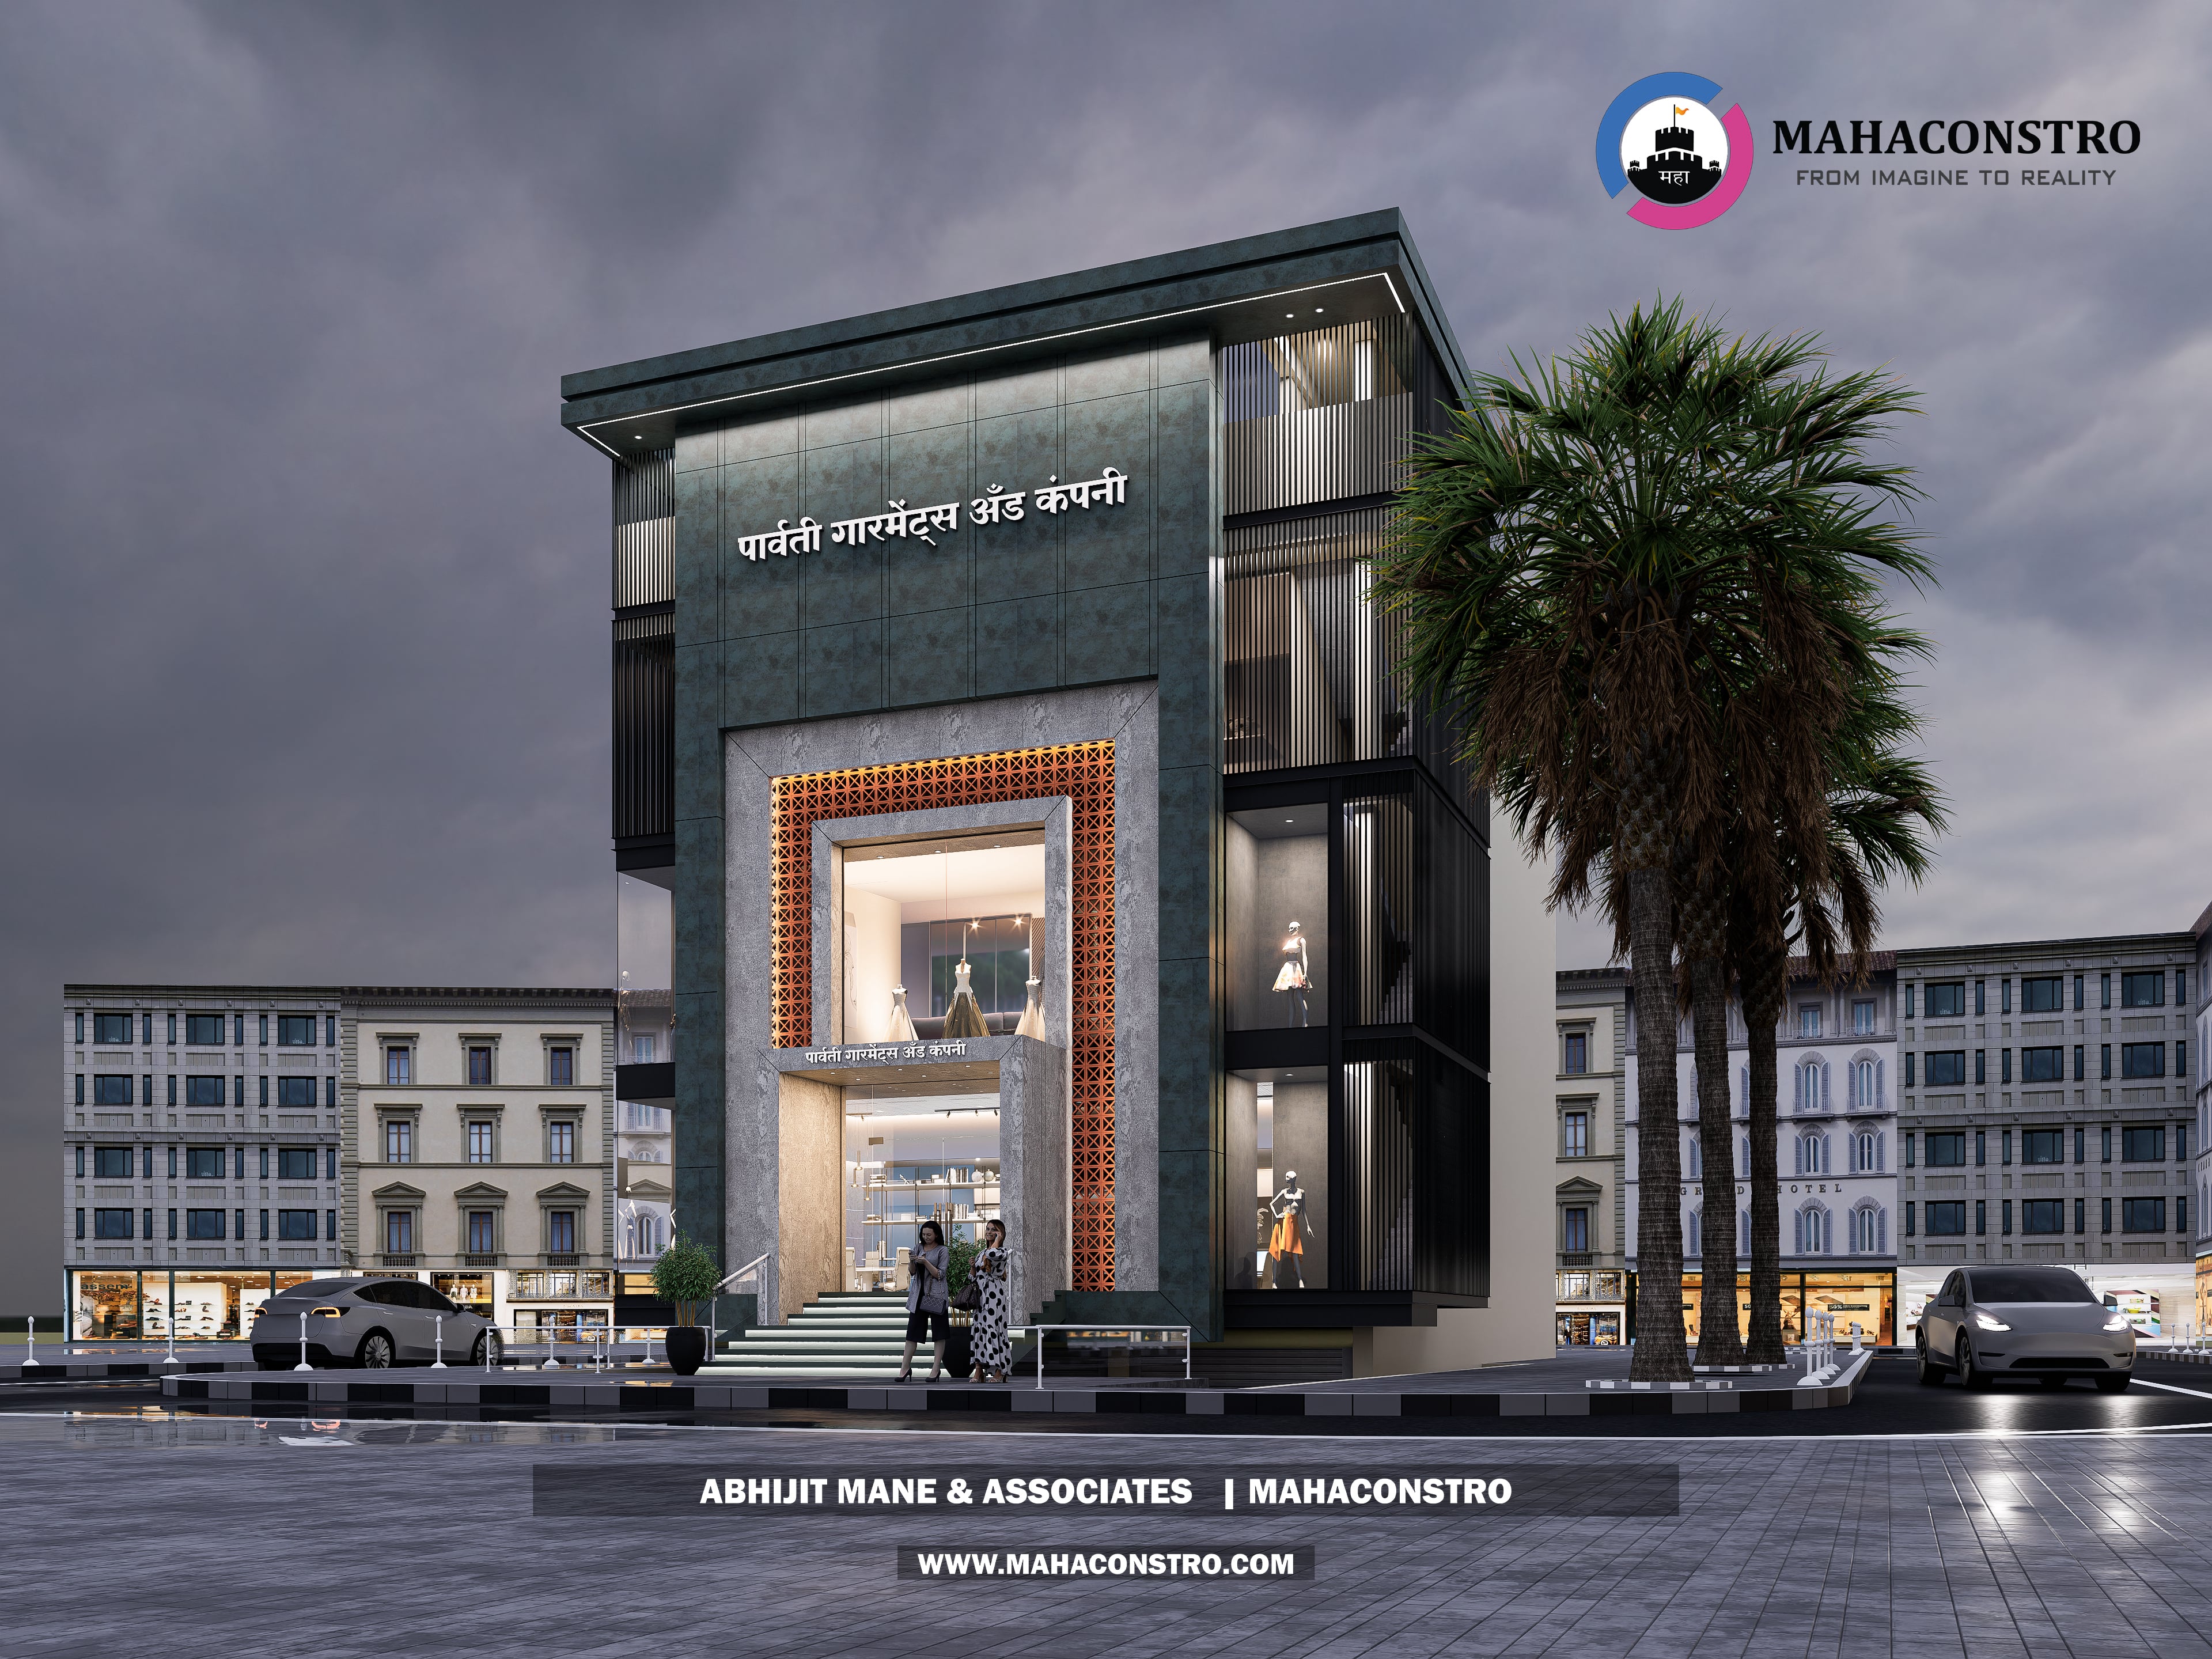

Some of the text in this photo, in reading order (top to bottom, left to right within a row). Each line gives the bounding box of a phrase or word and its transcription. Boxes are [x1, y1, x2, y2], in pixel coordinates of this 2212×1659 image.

[737, 518, 823, 561] पार्वती
[830, 498, 960, 546] गारमेंट्स
[1035, 467, 1128, 514] कंपनी
[805, 1047, 842, 1064] पार्वती
[845, 1043, 899, 1065] गारमेंट्स
[929, 1039, 967, 1057] कंपनी
[1680, 1185, 1745, 1195] GRD
